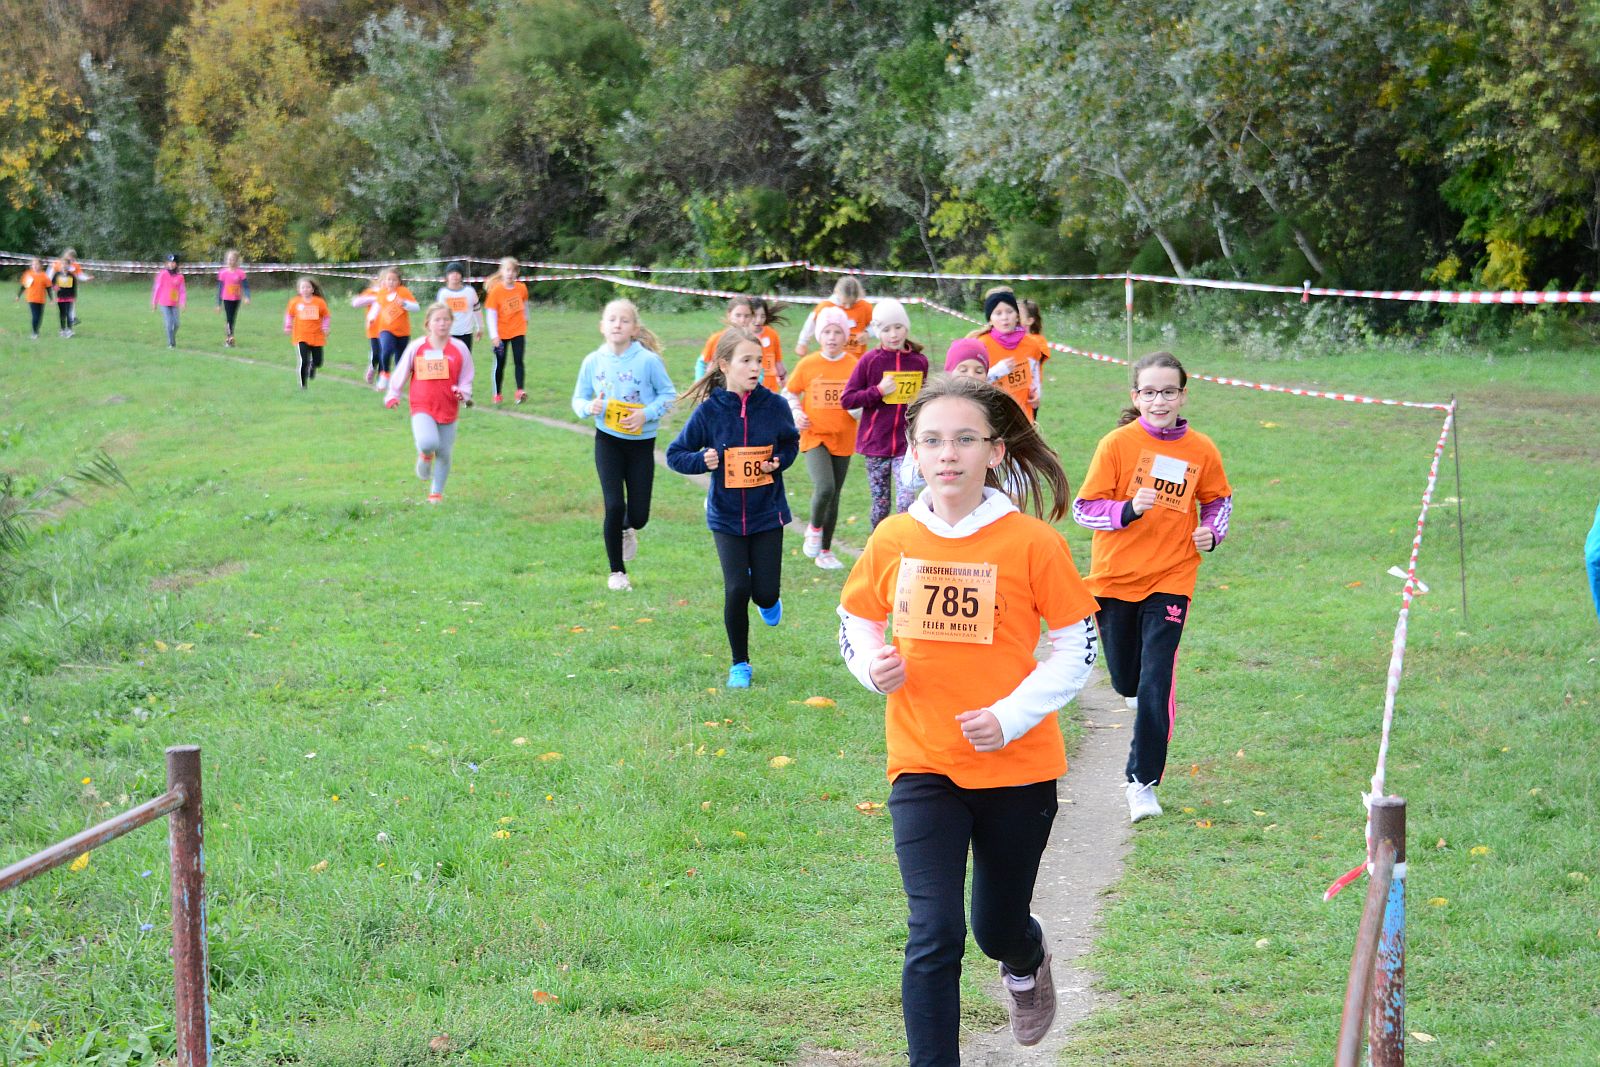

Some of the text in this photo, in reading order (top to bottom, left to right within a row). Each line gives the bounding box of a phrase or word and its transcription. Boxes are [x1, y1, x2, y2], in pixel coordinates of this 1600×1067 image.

[427, 362, 445, 371] 645
[1008, 369, 1026, 384] 651
[898, 381, 917, 394] 721
[825, 389, 843, 401] 68
[744, 461, 761, 476] 68
[923, 585, 979, 618] 785
[922, 620, 945, 630] FEJÉR
[950, 622, 978, 632] MEGYE
